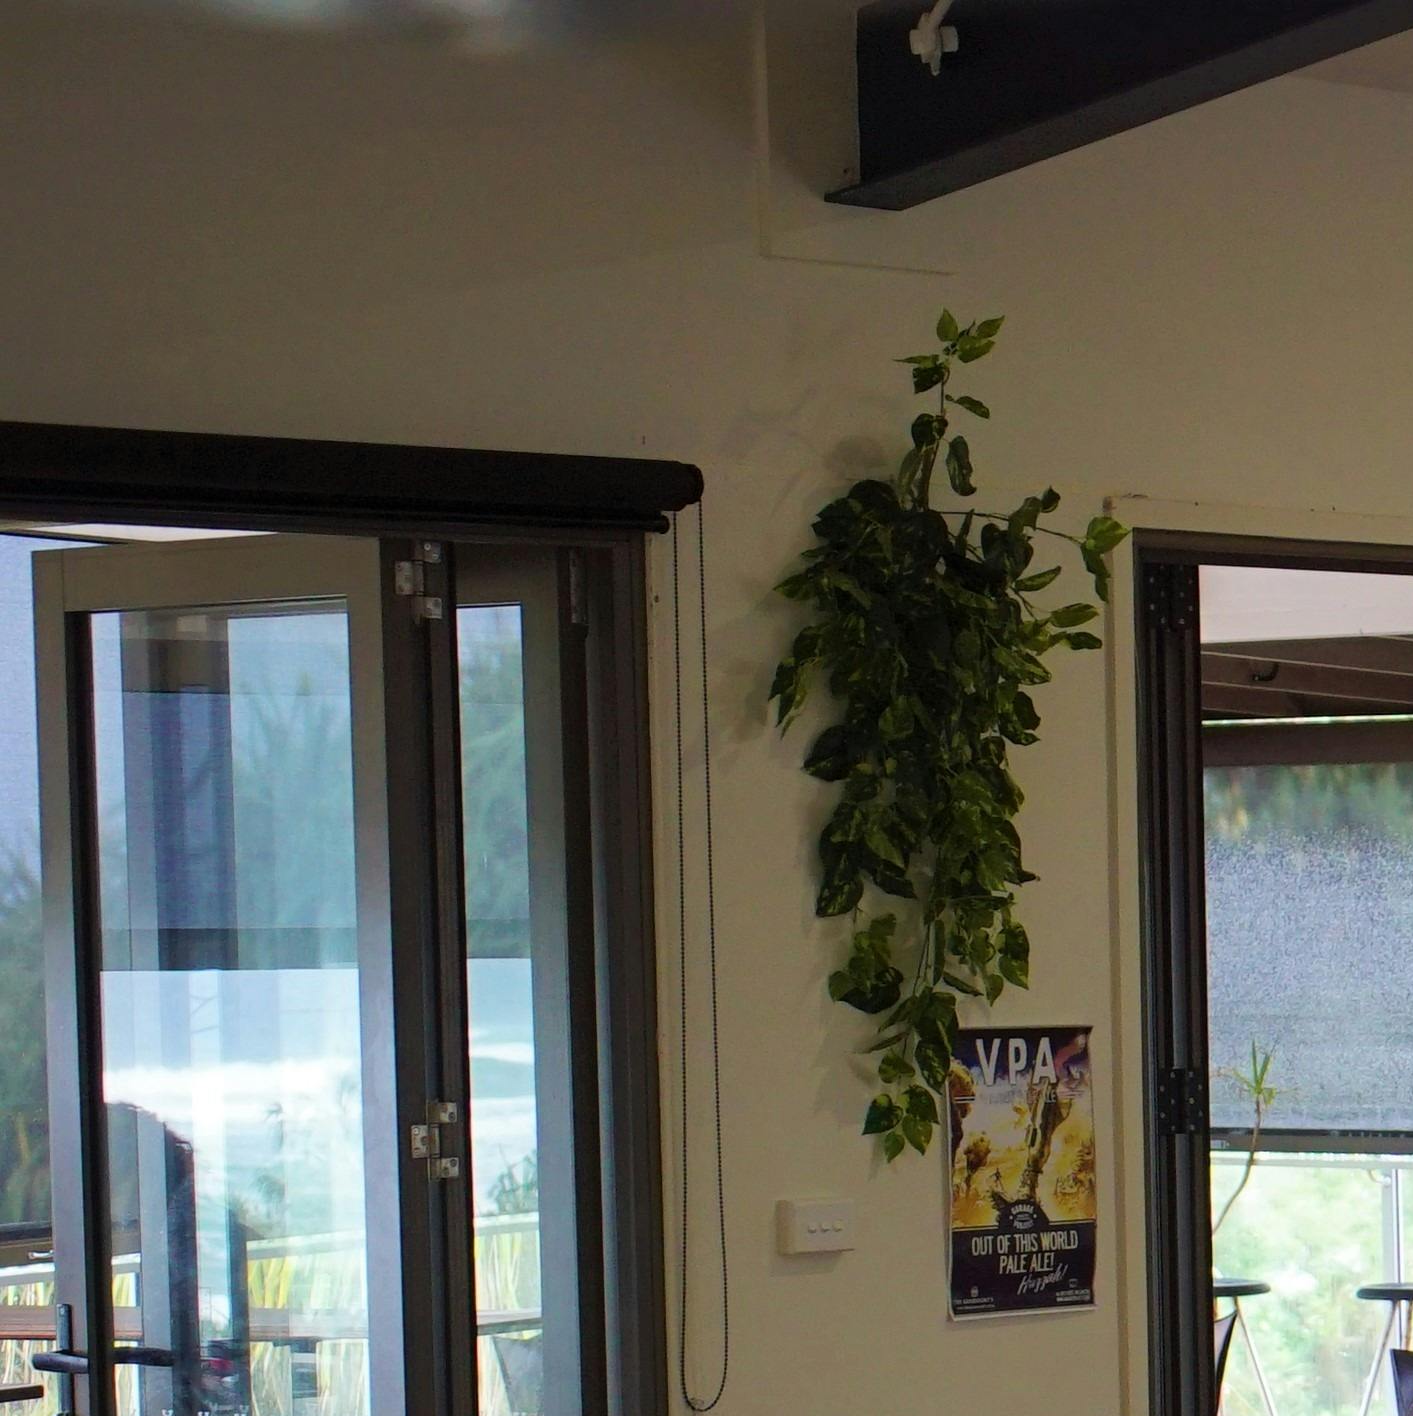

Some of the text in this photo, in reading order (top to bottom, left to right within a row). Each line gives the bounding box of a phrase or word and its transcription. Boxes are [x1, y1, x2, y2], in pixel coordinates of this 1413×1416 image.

[975, 1036, 1058, 1086] VPA
[972, 1230, 1079, 1256] OUT OF THIS WORLD
[999, 1252, 1055, 1275] PALE ALE!
